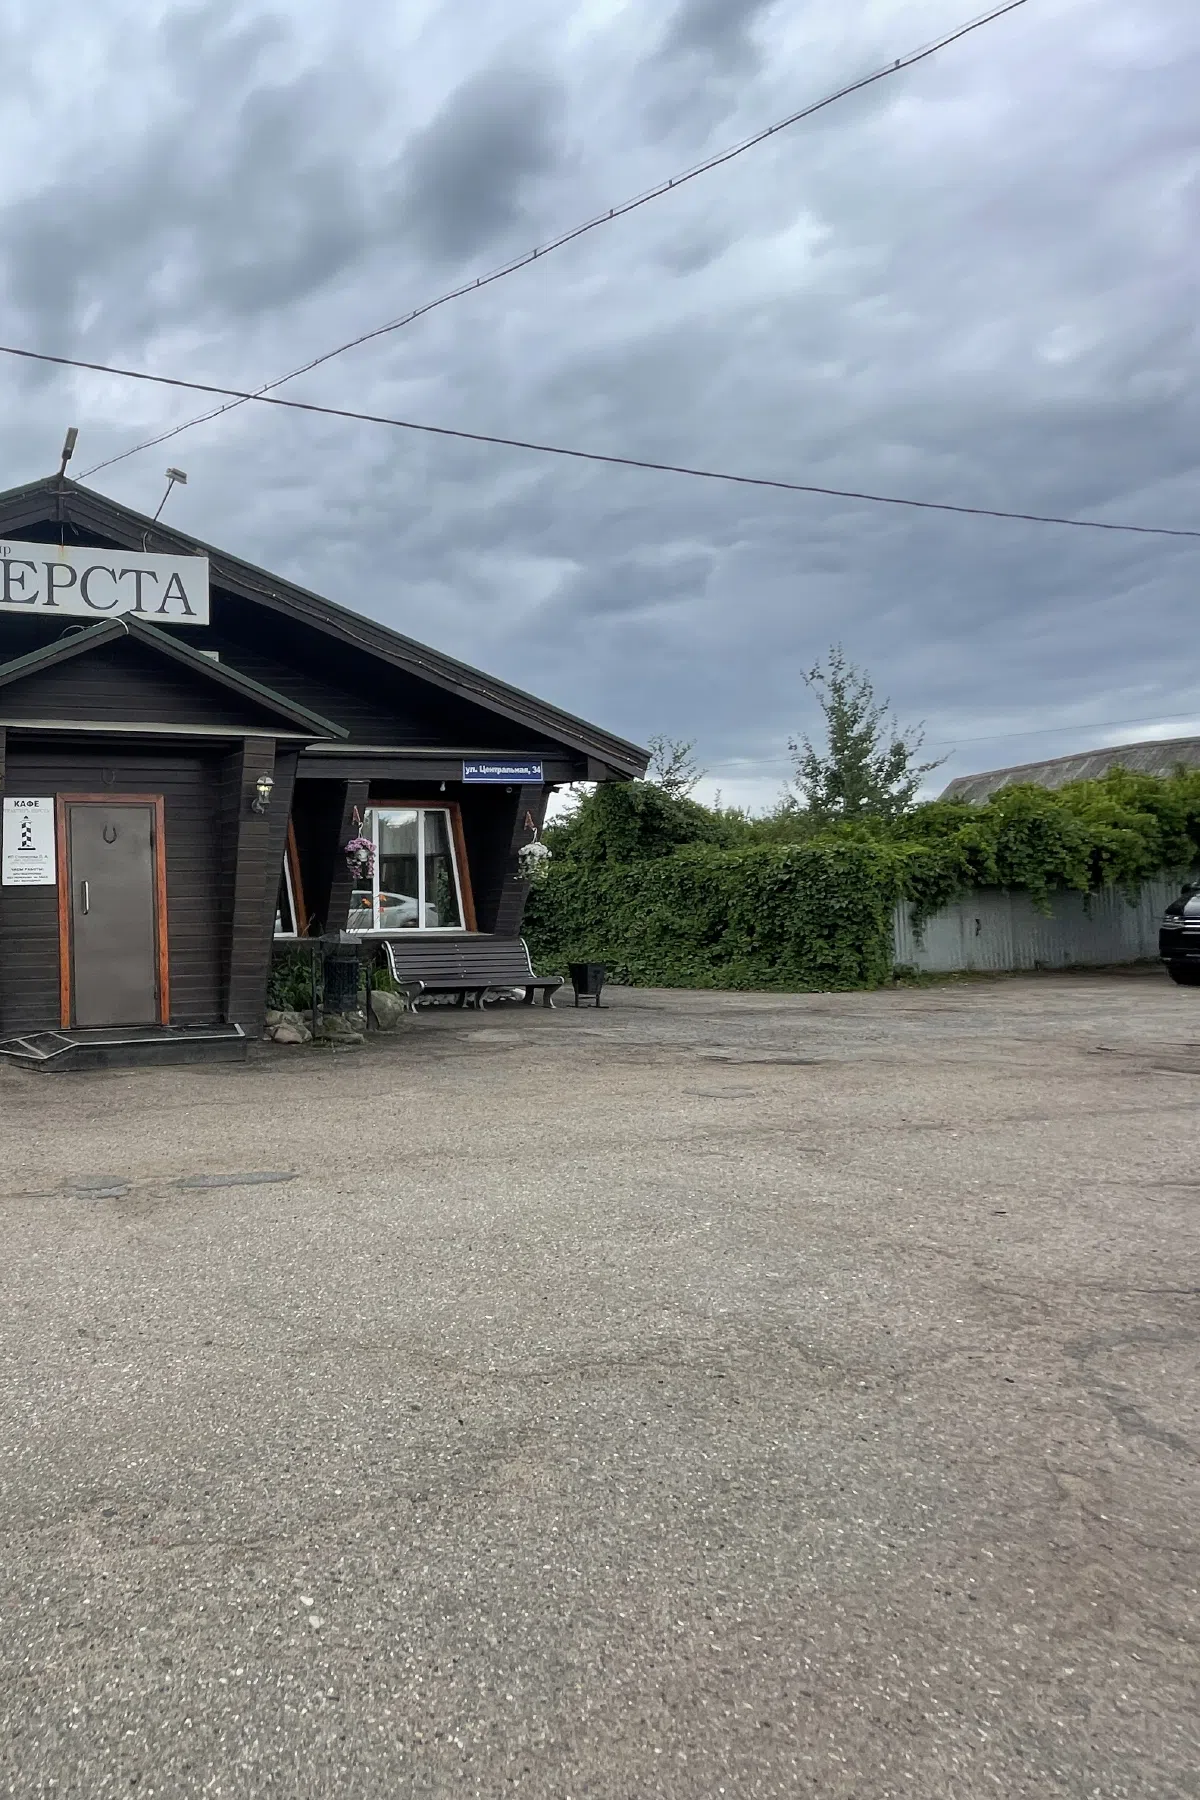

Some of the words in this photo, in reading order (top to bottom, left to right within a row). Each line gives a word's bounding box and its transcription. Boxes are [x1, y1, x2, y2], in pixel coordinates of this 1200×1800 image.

[465, 766, 478, 775] ул.
[479, 765, 531, 775] Центральная,
[532, 765, 541, 774] 34
